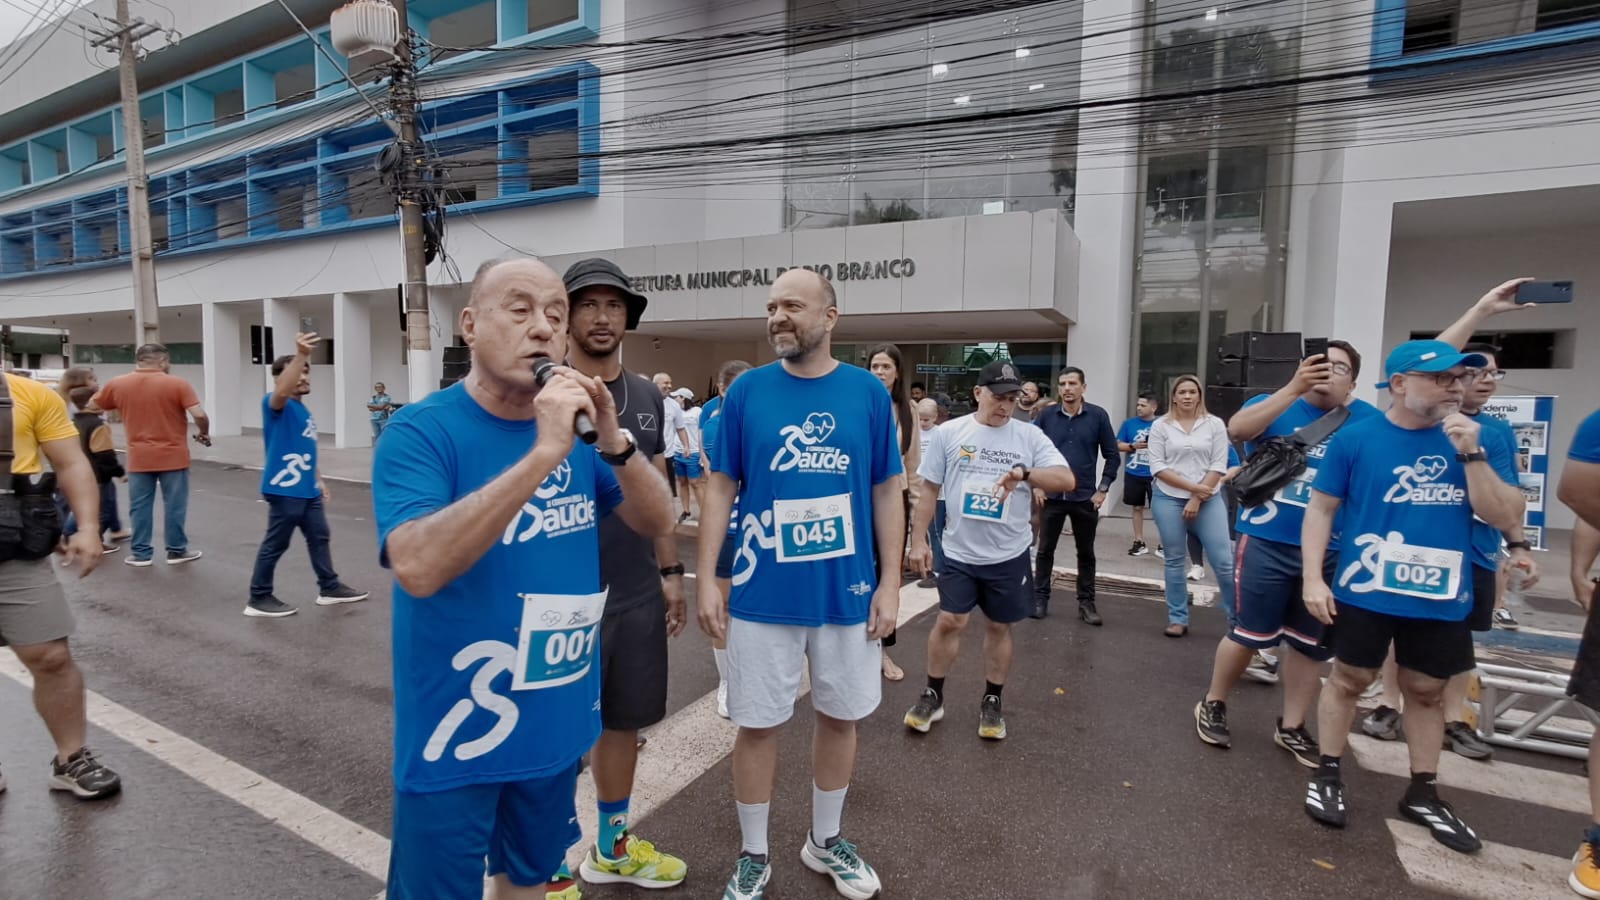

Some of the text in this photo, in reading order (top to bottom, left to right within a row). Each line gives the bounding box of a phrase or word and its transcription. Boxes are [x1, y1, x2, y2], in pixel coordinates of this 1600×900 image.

[687, 268, 774, 291] MUNICIPAL
[837, 258, 916, 281] BRANCO
[980, 447, 1021, 460] Academia
[970, 494, 1000, 512] 232
[792, 519, 837, 547] 045
[1394, 564, 1442, 587] 002
[545, 624, 597, 665] 001
